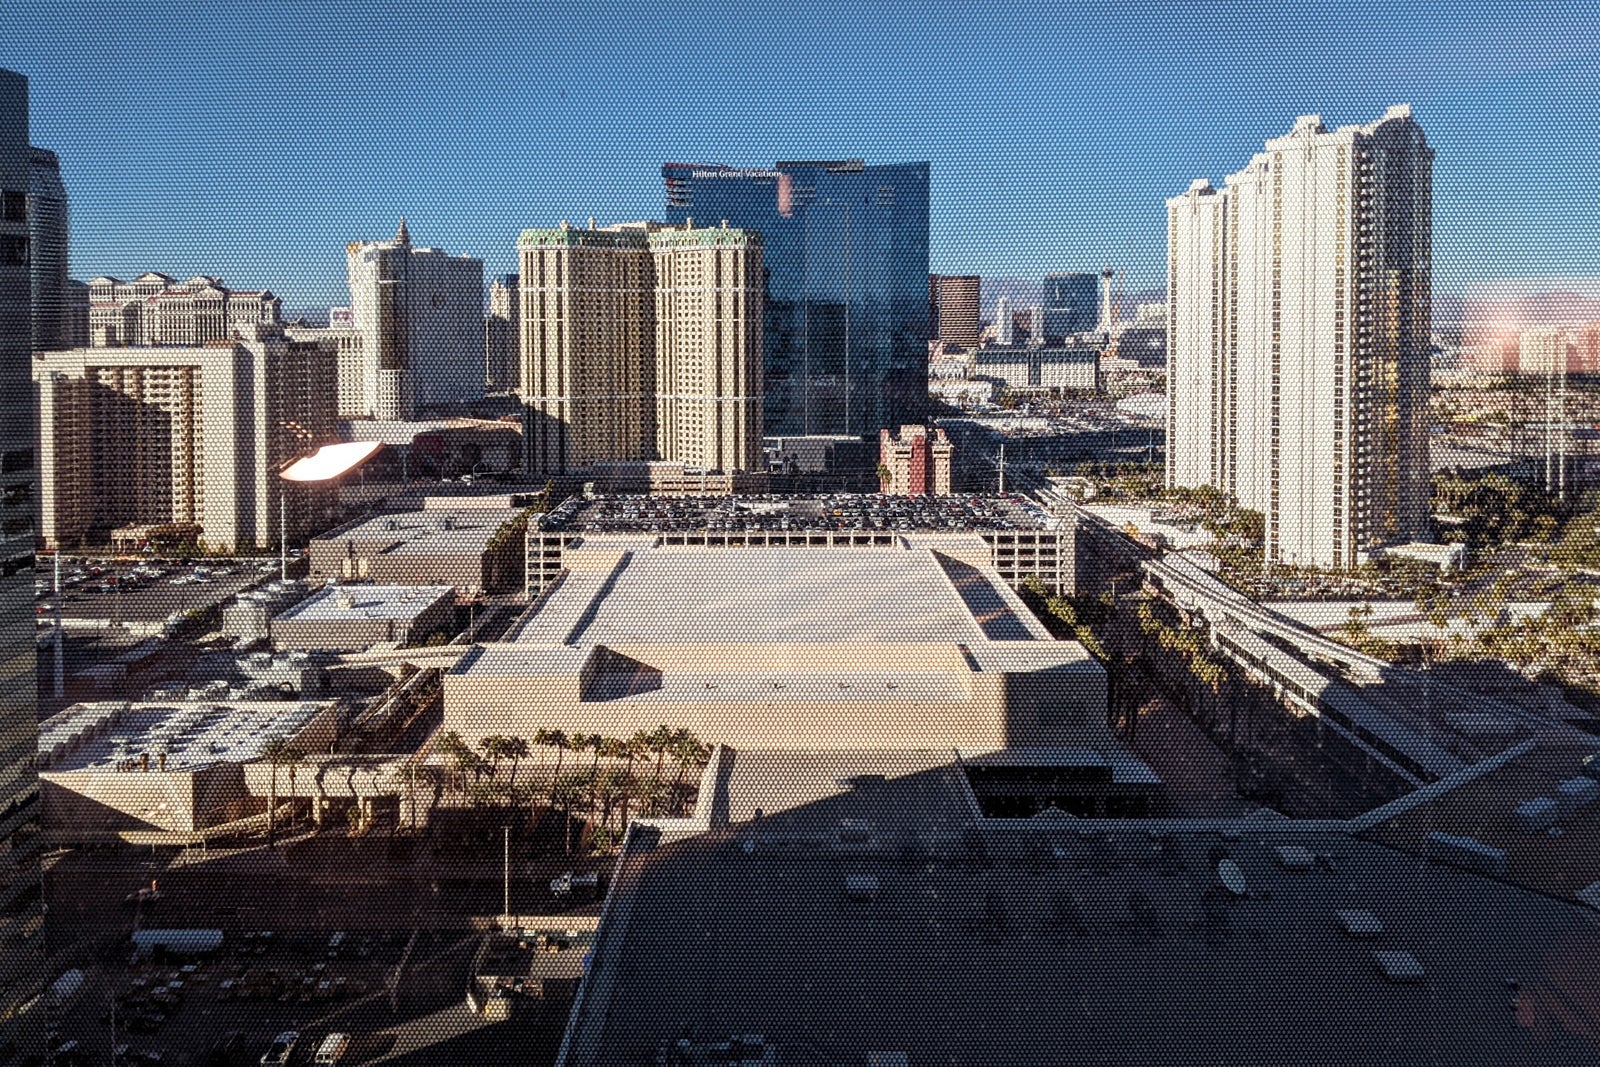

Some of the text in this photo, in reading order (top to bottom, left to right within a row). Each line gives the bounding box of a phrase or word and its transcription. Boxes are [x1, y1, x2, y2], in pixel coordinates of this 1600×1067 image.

[692, 169, 782, 178] Hilton Grand Vacations
